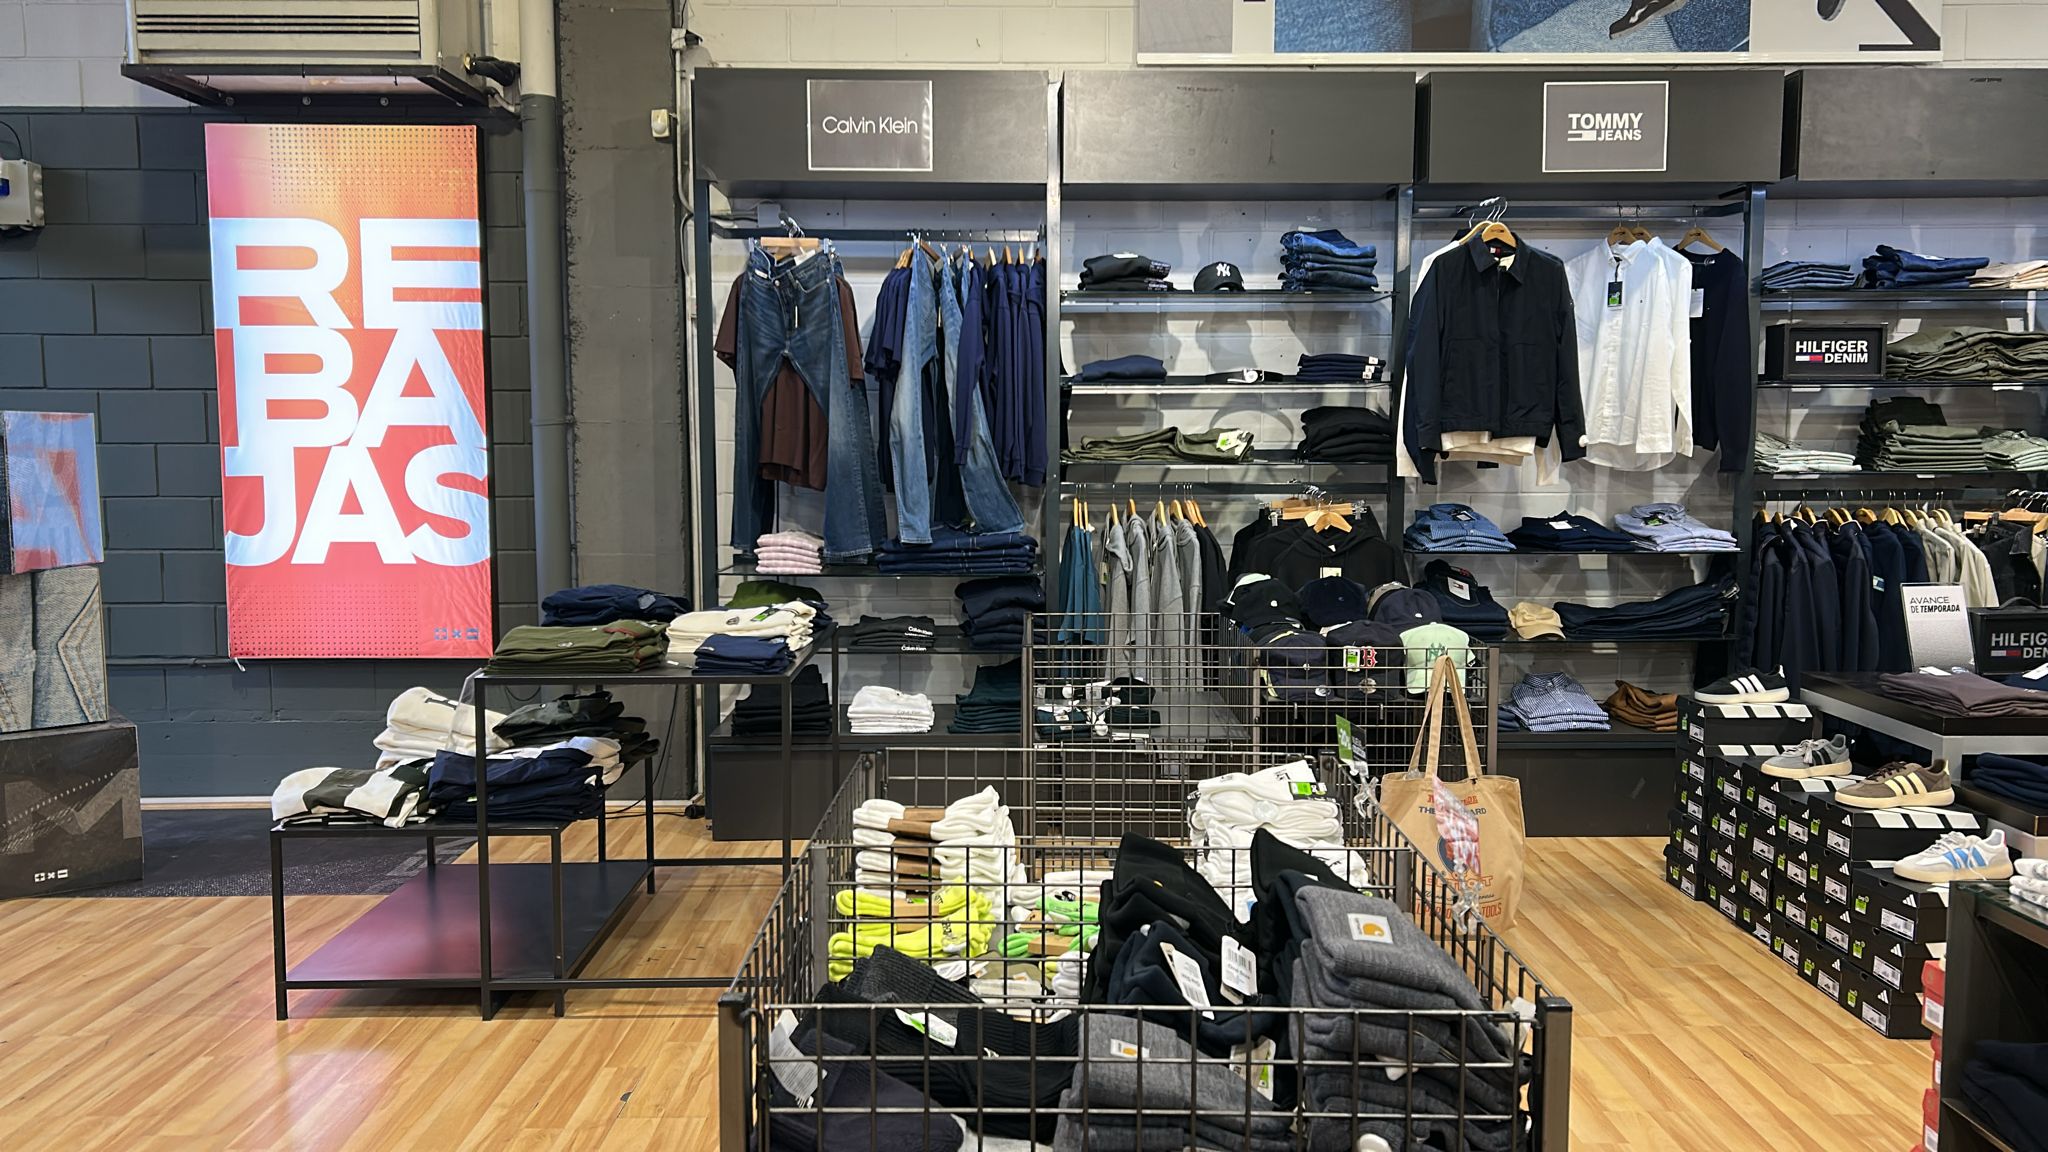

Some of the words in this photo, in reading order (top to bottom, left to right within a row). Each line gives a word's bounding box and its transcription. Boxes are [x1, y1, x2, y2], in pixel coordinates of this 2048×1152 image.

[822, 116, 876, 134] Calvin
[879, 116, 918, 134] Klein
[1567, 112, 1644, 130] TOMMY
[1597, 129, 1642, 141] JEANS
[1795, 340, 1868, 353] HILFIGER
[1824, 352, 1868, 363] DENIM
[1909, 596, 1950, 605] AVANCE
[1910, 604, 1920, 614] DE
[1920, 604, 1961, 614] TEMPORADA
